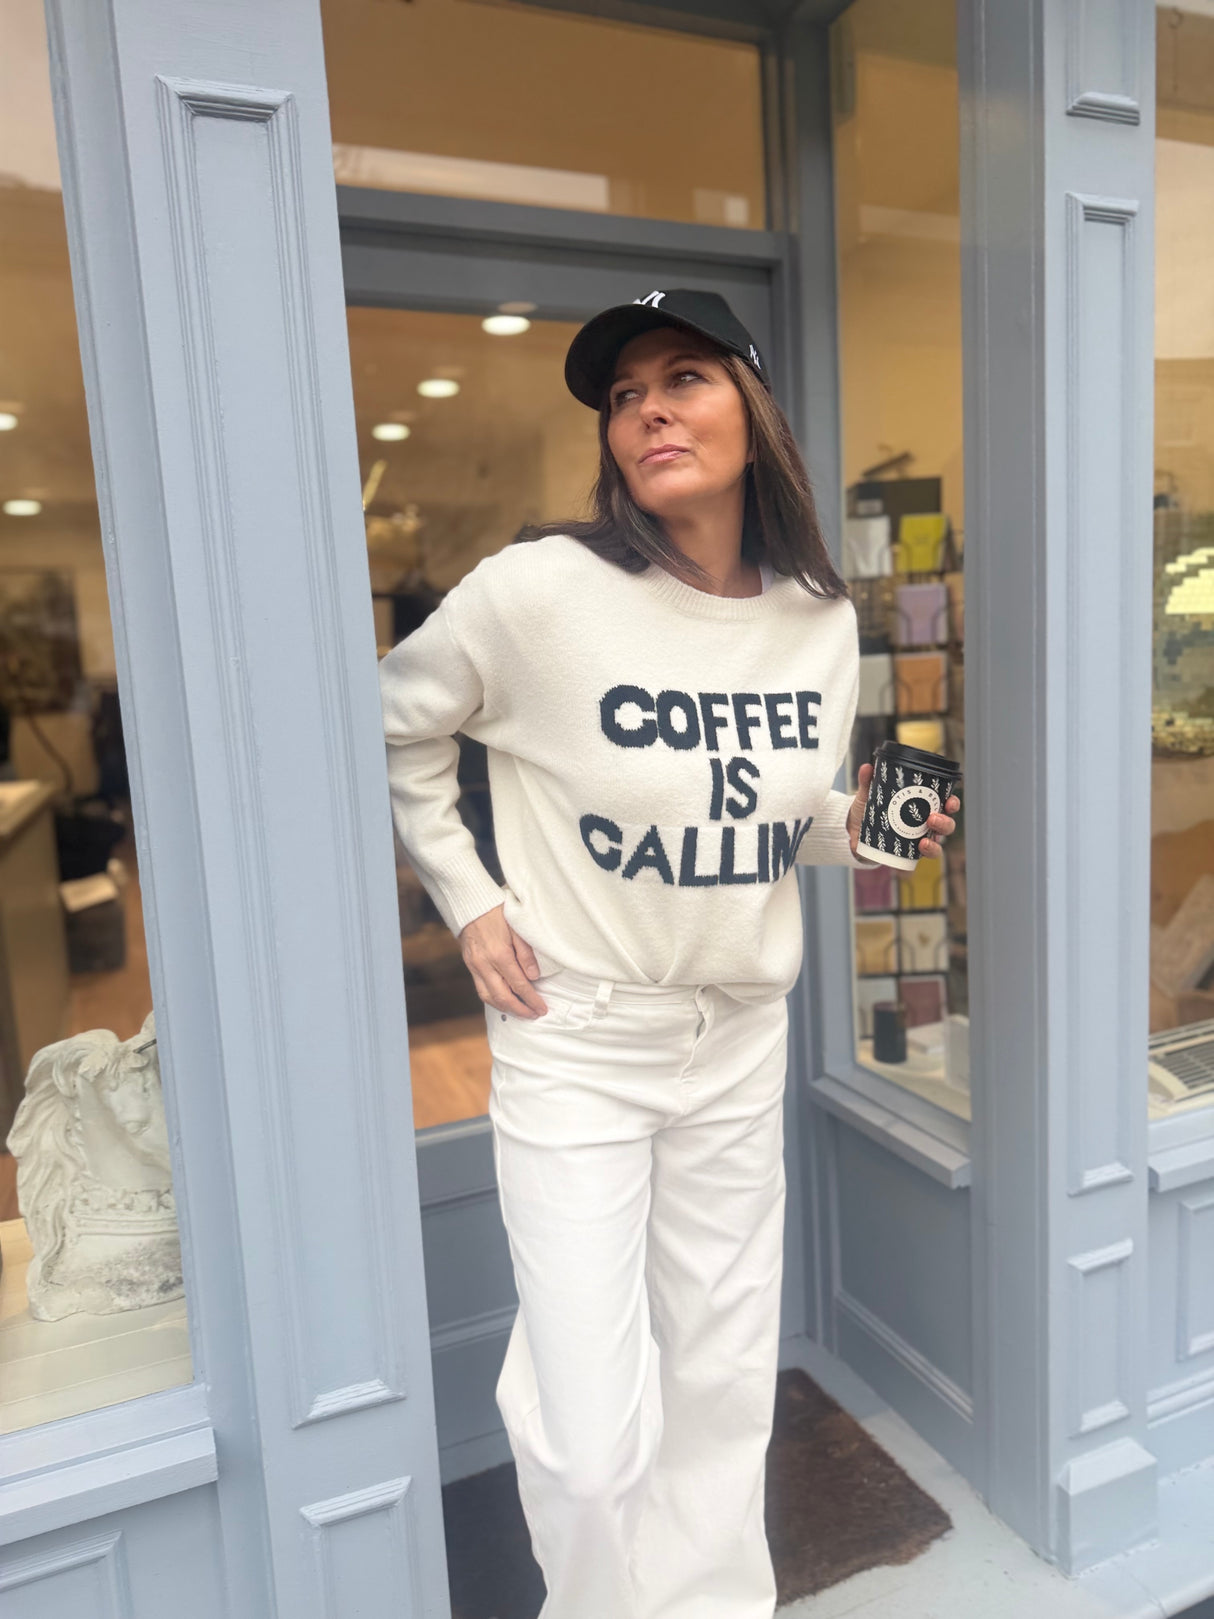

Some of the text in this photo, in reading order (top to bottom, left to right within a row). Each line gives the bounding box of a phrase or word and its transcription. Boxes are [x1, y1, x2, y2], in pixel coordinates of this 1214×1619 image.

[599, 684, 822, 751] COFFEE
[709, 756, 761, 821] IS
[892, 790, 912, 806] OTIS
[928, 792, 938, 811] BELL
[579, 813, 814, 886] CALLIN
